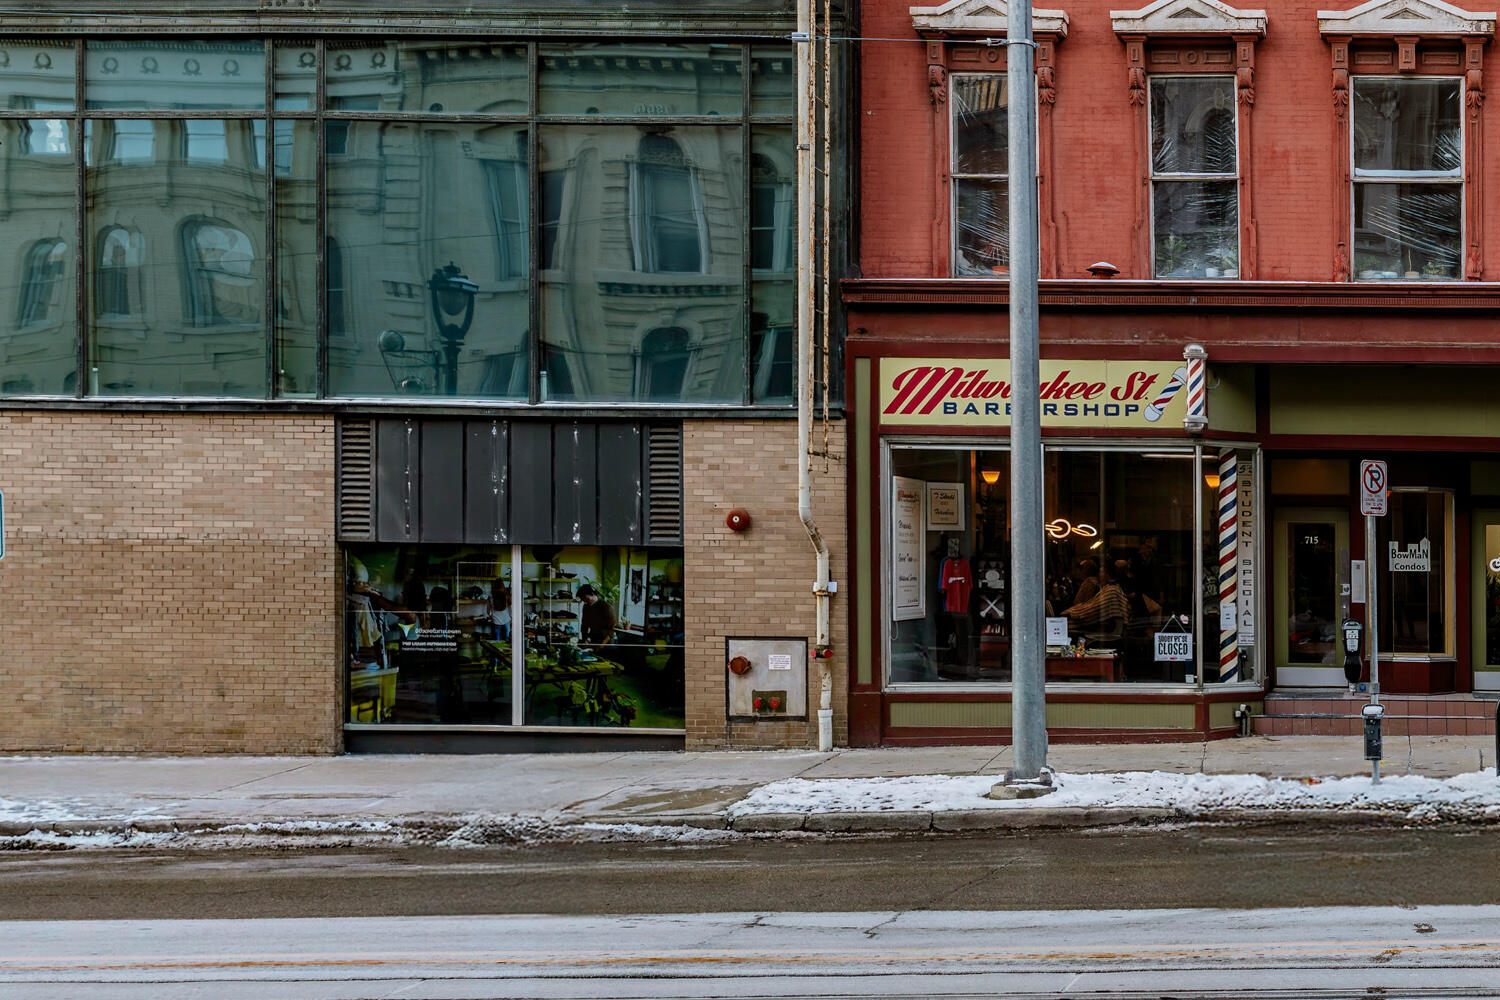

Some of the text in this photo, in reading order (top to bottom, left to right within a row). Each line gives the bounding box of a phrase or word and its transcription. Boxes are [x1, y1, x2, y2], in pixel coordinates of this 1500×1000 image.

[1111, 371, 1160, 401] St.
[944, 402, 1139, 417] BARRSHOP
[1241, 480, 1252, 547] STUDENT
[1305, 535, 1319, 545] 715
[1394, 562, 1426, 571] Condos
[1242, 559, 1253, 627] SPECIAL
[1158, 643, 1188, 655] CLOSED
